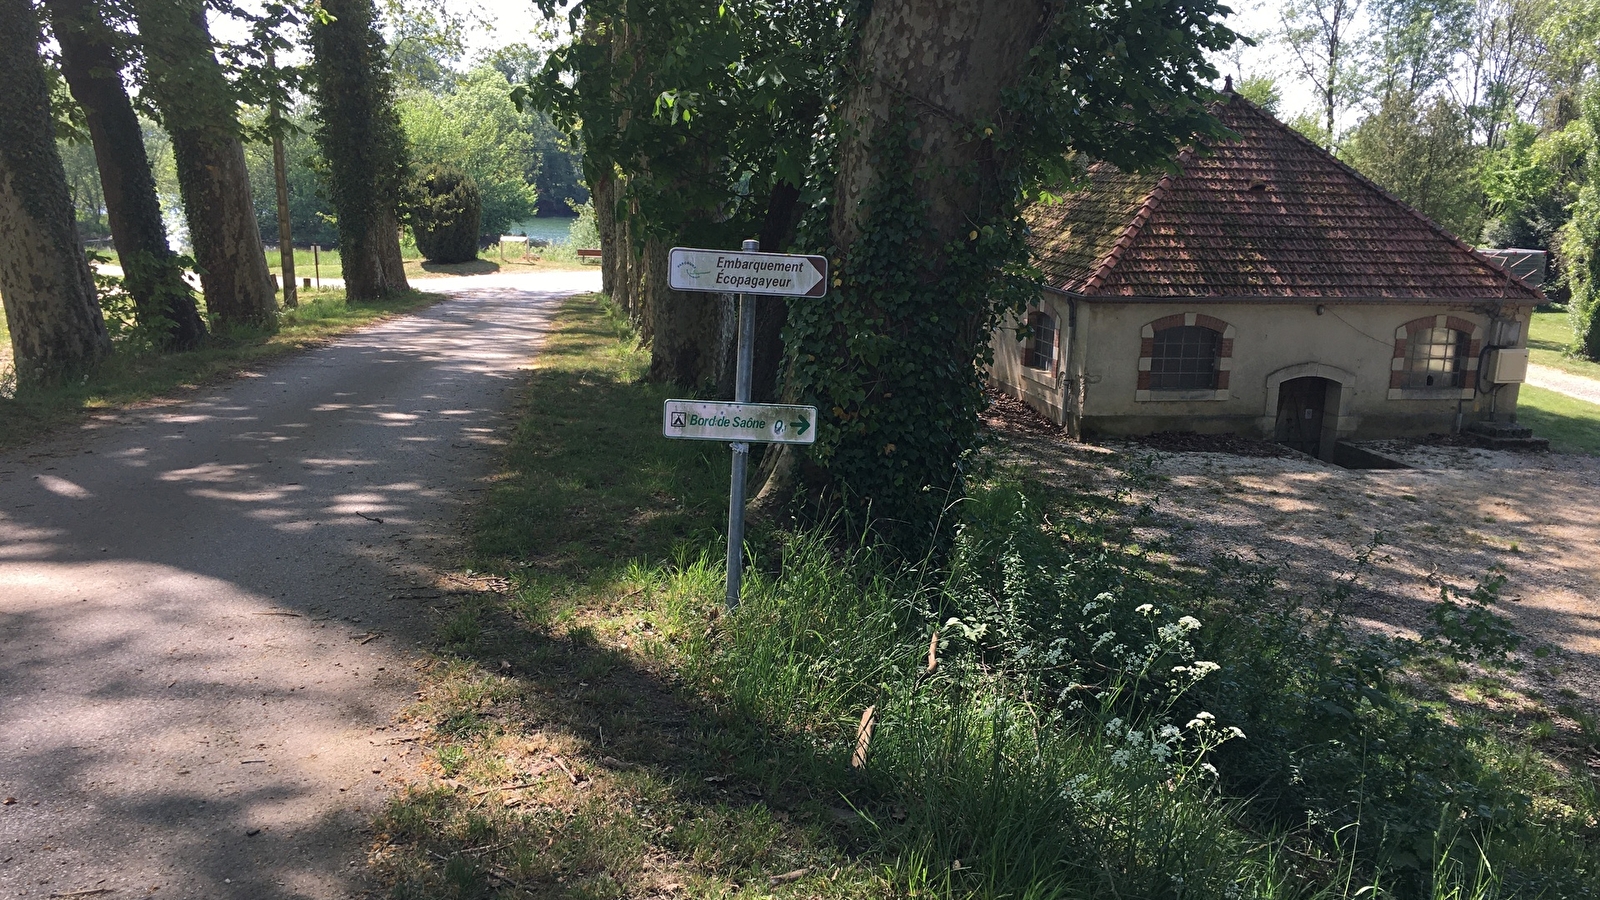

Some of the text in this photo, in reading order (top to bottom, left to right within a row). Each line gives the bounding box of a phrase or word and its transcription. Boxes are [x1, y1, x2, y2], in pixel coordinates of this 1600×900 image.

[716, 256, 804, 273] Embarquement
[715, 269, 791, 288] Écopagayeur
[689, 414, 717, 426] Bord
[717, 415, 730, 427] de
[732, 416, 766, 429] Saône
